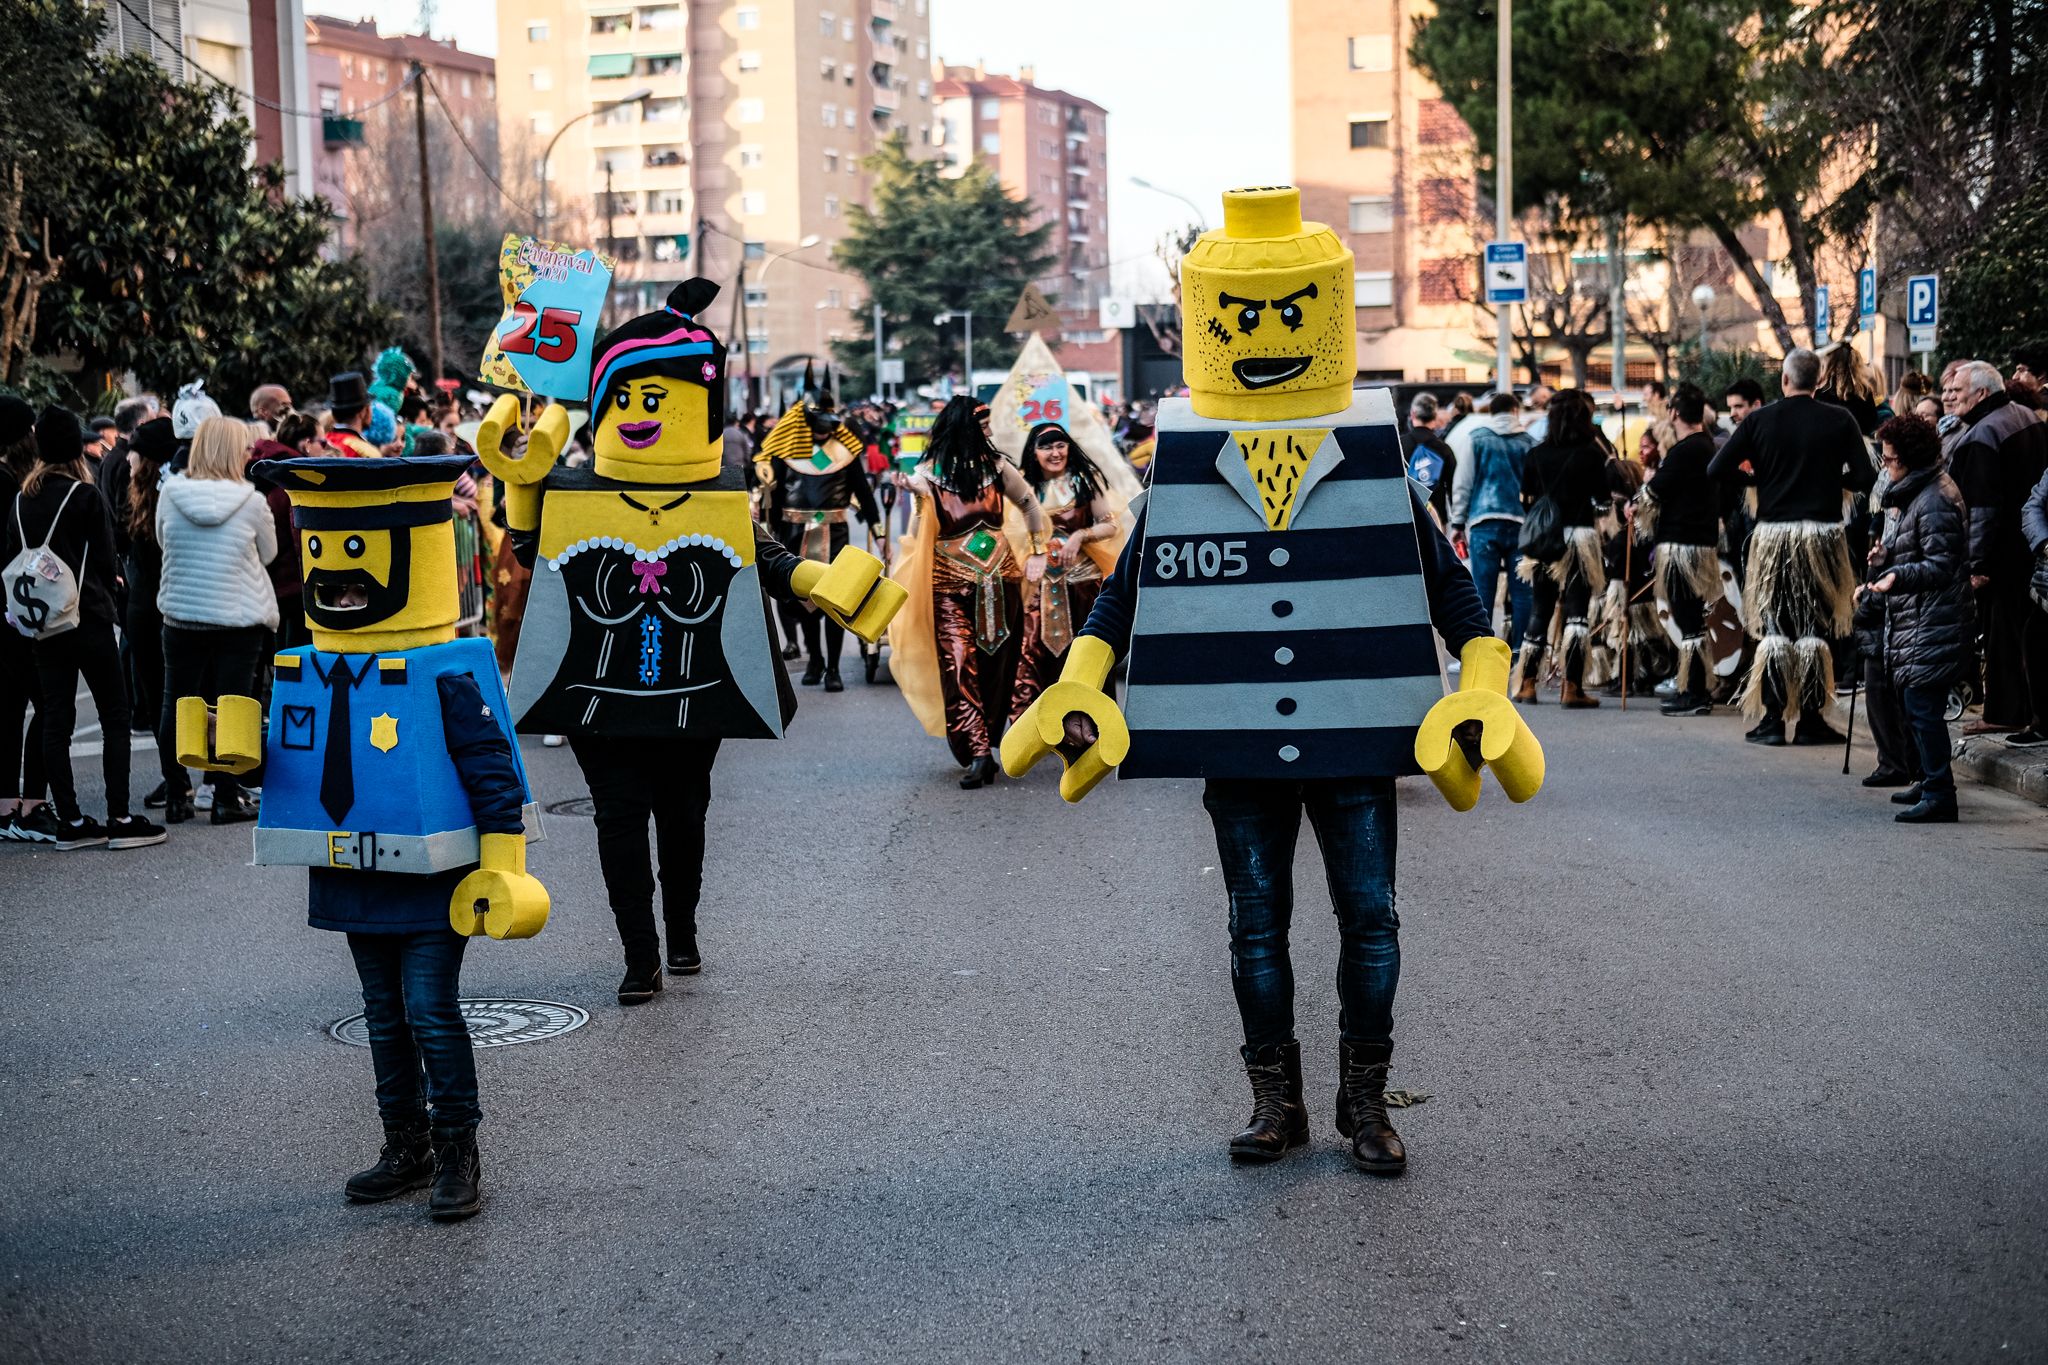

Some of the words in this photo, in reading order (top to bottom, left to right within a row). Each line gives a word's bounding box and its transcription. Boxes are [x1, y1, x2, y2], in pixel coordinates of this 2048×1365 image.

[517, 241, 596, 276] Carnaval
[535, 265, 568, 283] 2020
[1817, 291, 1825, 327] P
[1863, 274, 1872, 311] P
[1913, 281, 1931, 322] P
[498, 301, 582, 363] 25
[180, 410, 188, 425] $
[1023, 400, 1063, 422] 26
[1156, 541, 1248, 579] 8105
[13, 571, 50, 632] $
